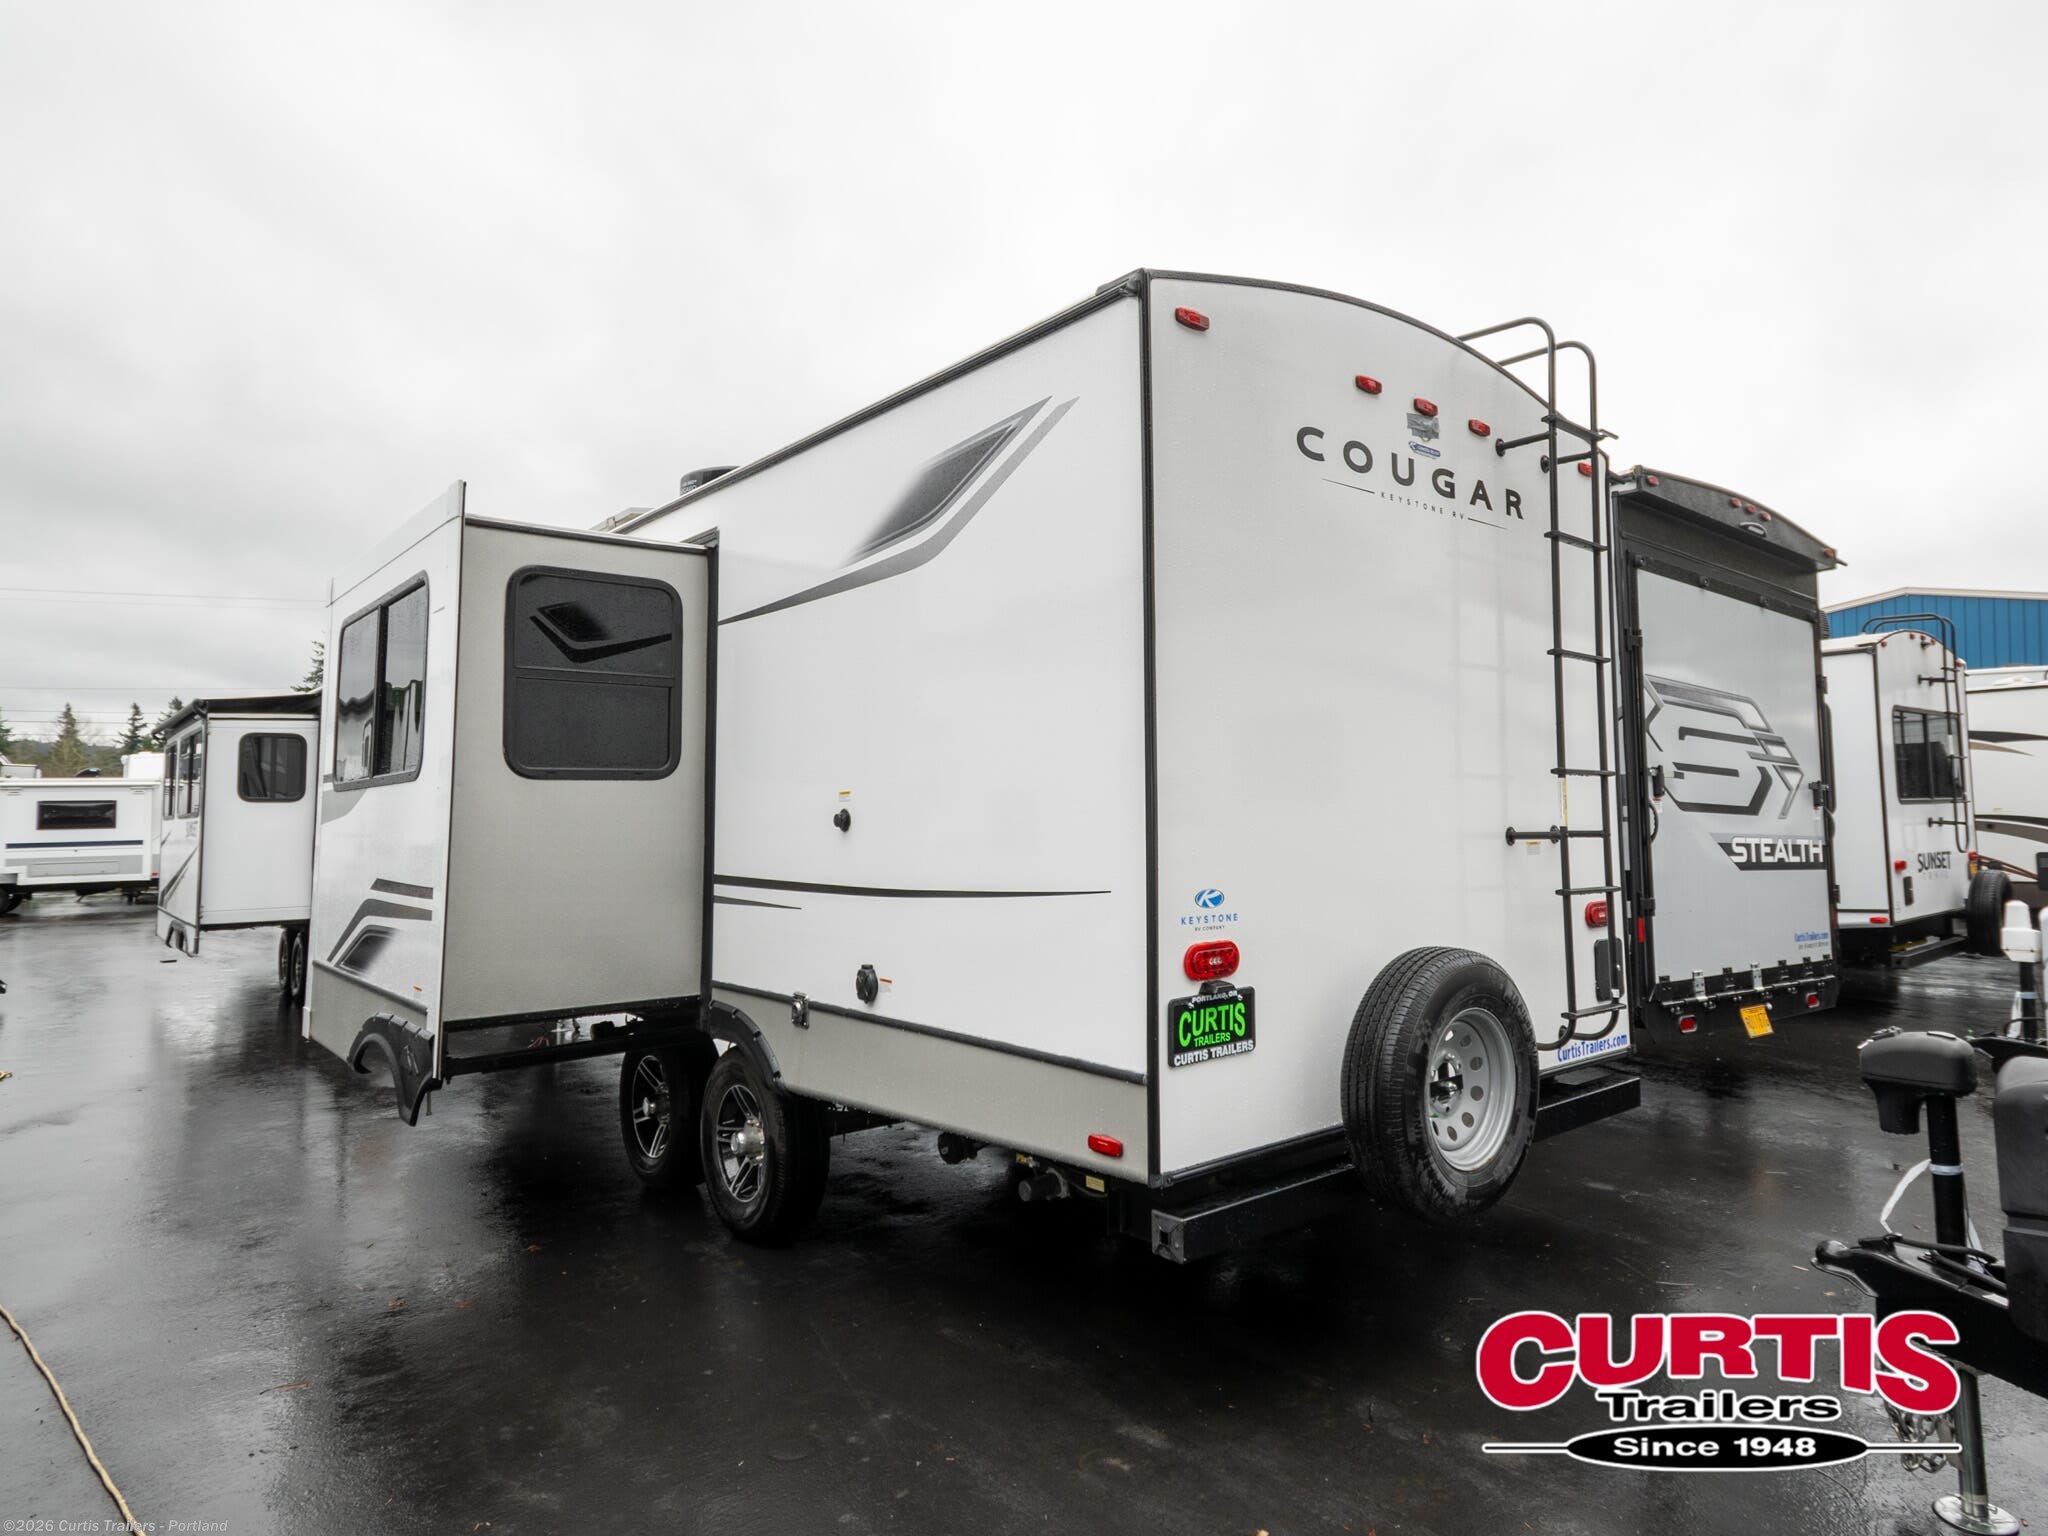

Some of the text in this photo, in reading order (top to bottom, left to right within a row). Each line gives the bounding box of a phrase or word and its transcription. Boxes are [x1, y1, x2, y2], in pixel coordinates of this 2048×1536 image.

[1296, 426, 1524, 520] COUGAR
[1381, 492, 1443, 514] KEYSTONE
[1729, 836, 1824, 863] STEALTH
[1917, 851, 1951, 872] SUNSET
[1180, 913, 1239, 926] KEYSTONE
[1178, 1002, 1246, 1047] CURTIS
[1174, 1039, 1254, 1067] CURTIS TRAILERS
[1194, 1032, 1231, 1047] TRAILERS
[1557, 1034, 1628, 1062] CurtisTrailers.com
